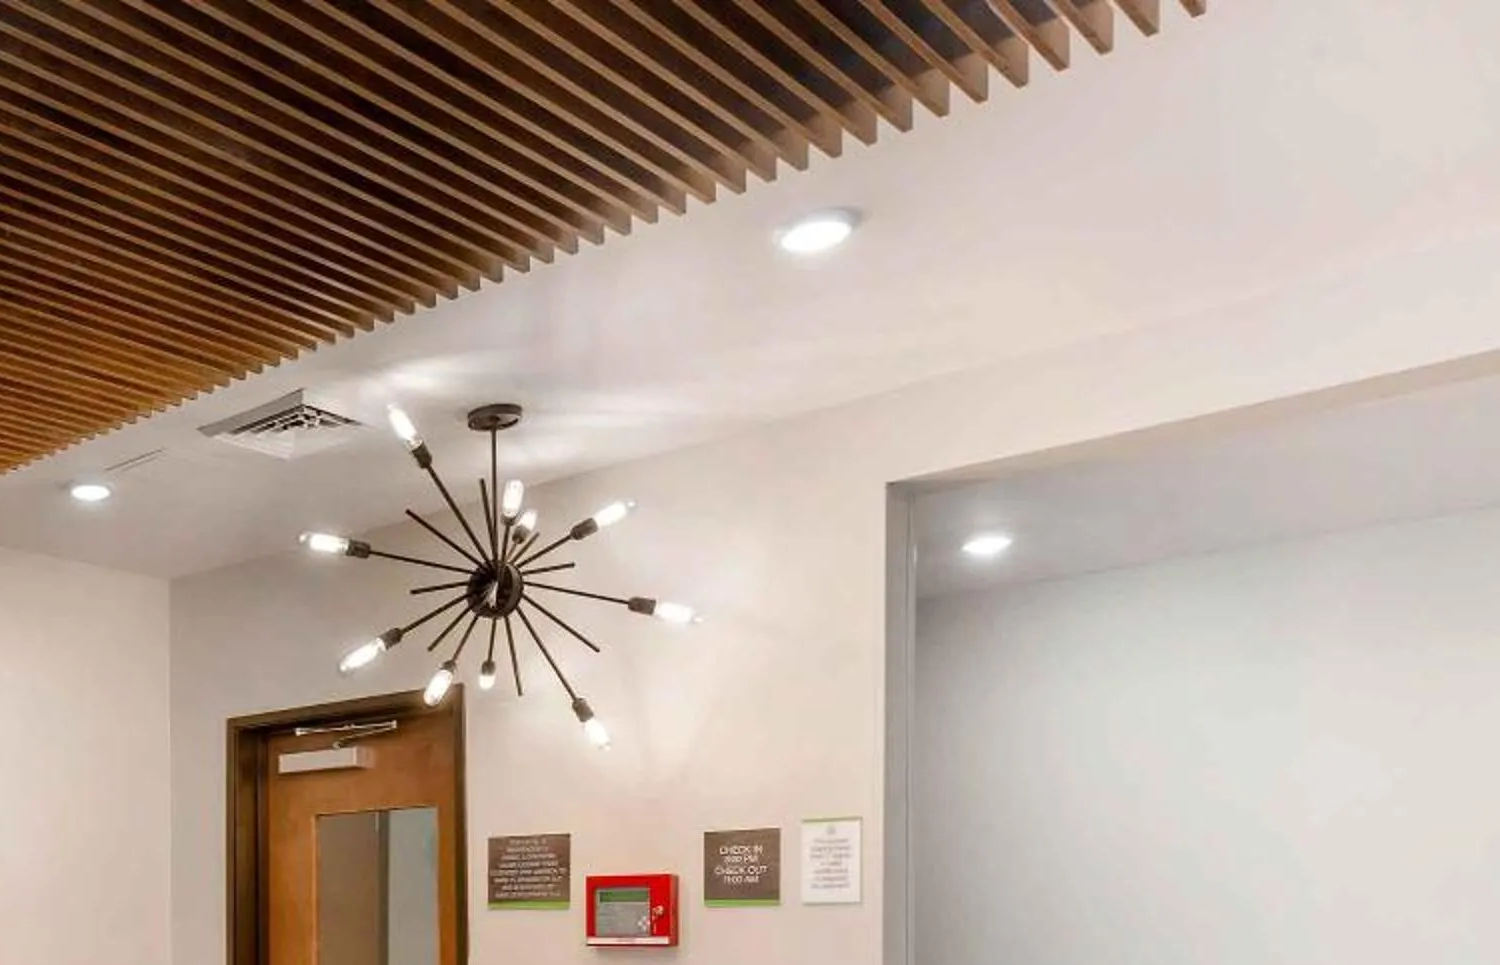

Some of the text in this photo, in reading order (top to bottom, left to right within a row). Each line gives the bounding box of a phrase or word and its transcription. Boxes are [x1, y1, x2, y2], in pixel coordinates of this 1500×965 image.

[719, 845, 764, 855] CHECK IN
[714, 865, 768, 875] CHECK OUT
